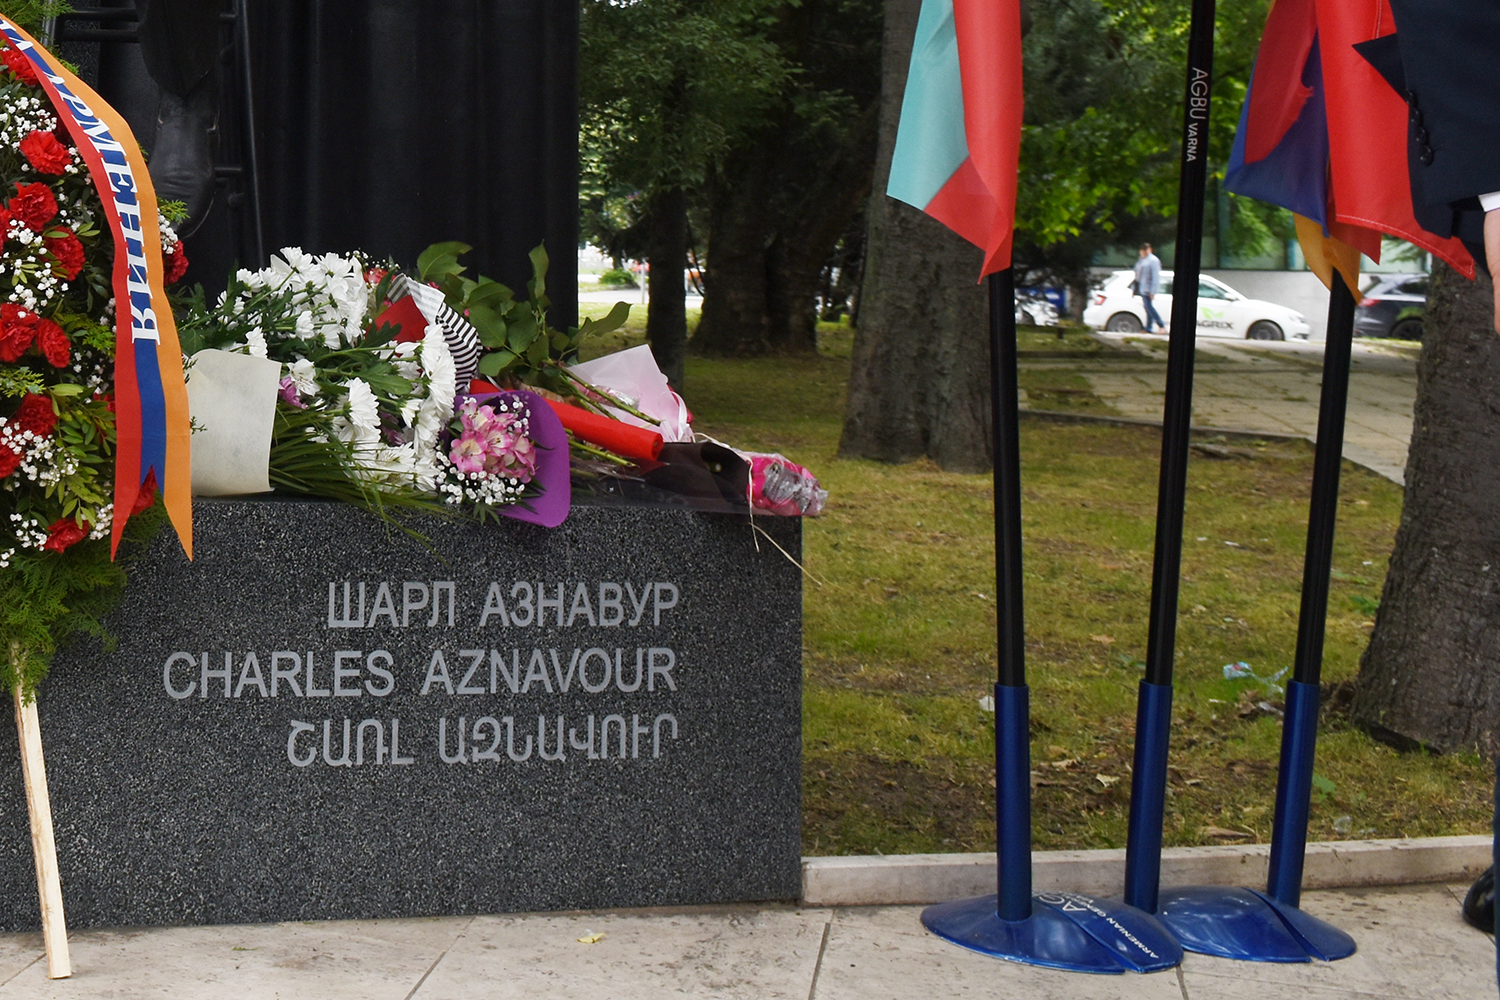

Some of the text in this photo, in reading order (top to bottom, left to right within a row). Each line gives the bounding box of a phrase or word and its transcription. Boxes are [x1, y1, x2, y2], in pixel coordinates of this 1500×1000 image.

[1187, 67, 1208, 162] AGBU VARNA
[43, 71, 161, 346] АРМЕНИЯ
[327, 579, 680, 629] ШАРЛ АЗНАВУР
[162, 646, 677, 699] CHARLES AZNAVOUR
[1106, 917, 1159, 958] ARMENIAN
